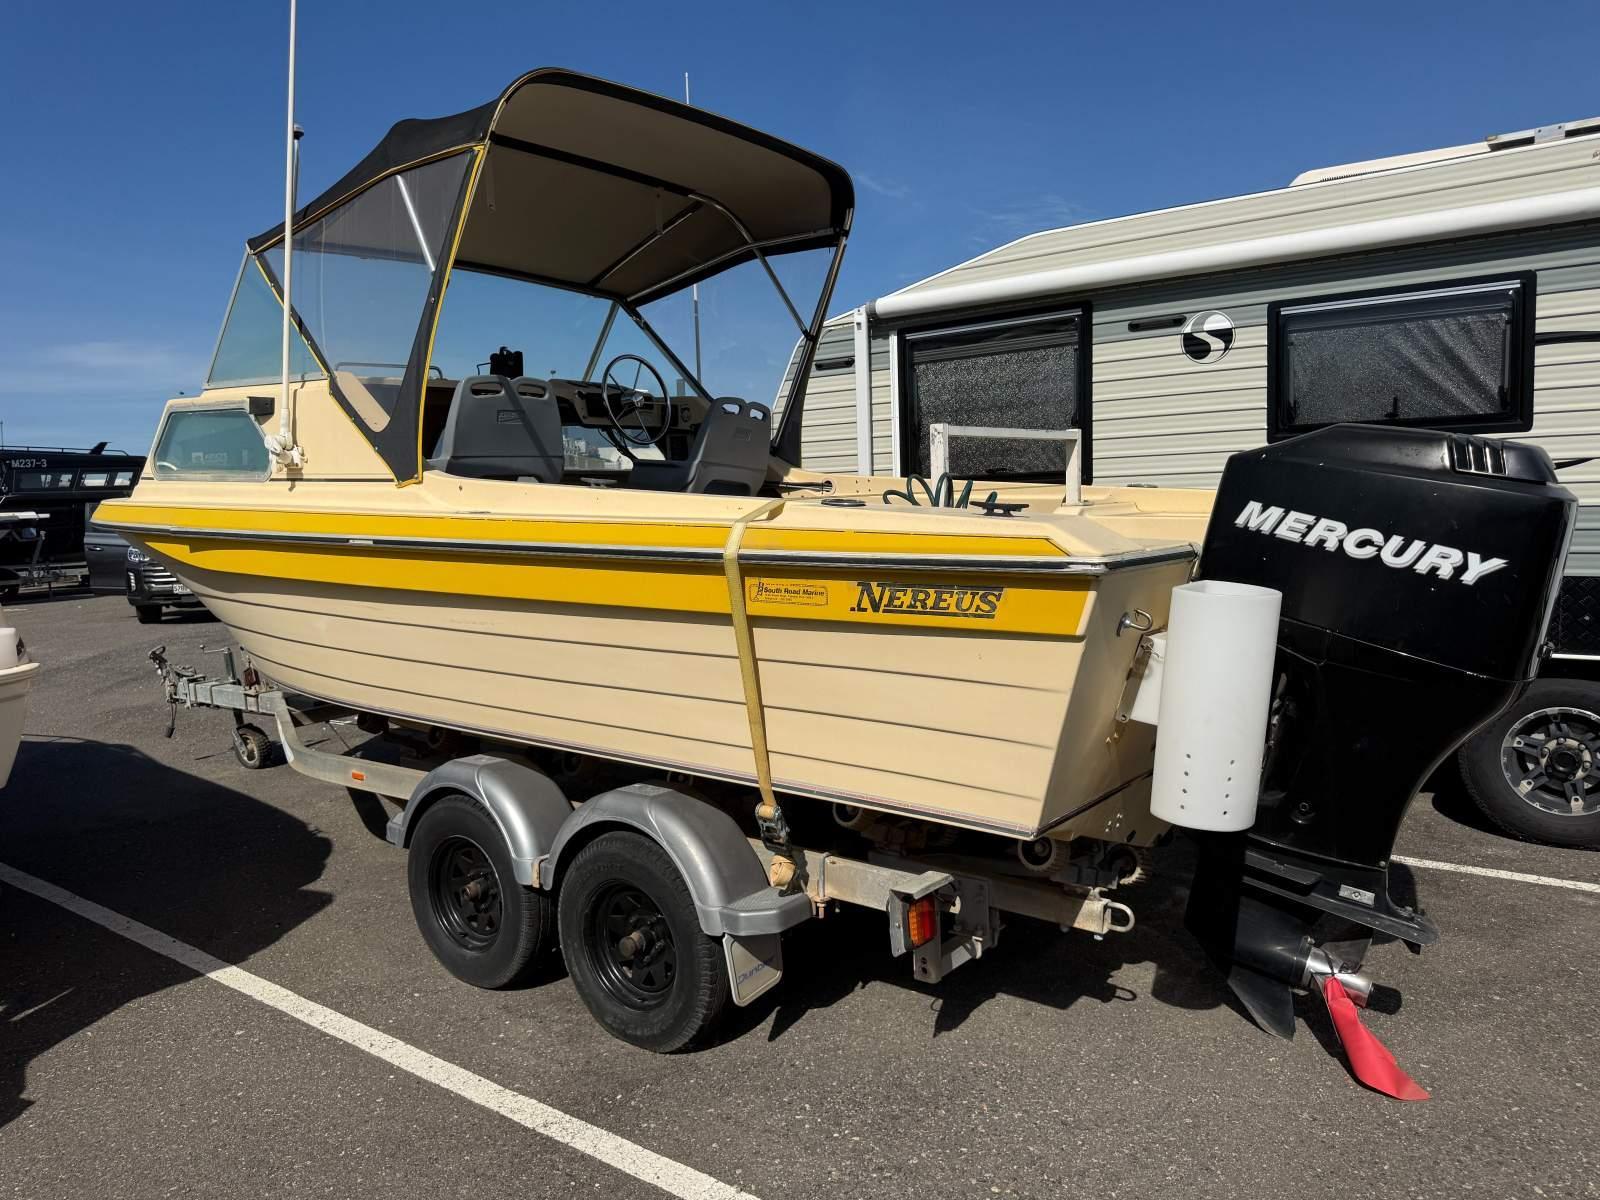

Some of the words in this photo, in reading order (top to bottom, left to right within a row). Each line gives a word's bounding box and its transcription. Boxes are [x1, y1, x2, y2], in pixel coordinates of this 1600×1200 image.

[11, 458, 48, 468] M237-3
[1234, 500, 1509, 585] MERCURY
[763, 586, 783, 594] South
[802, 588, 825, 597] Marine
[853, 581, 1003, 614] NEREUS
